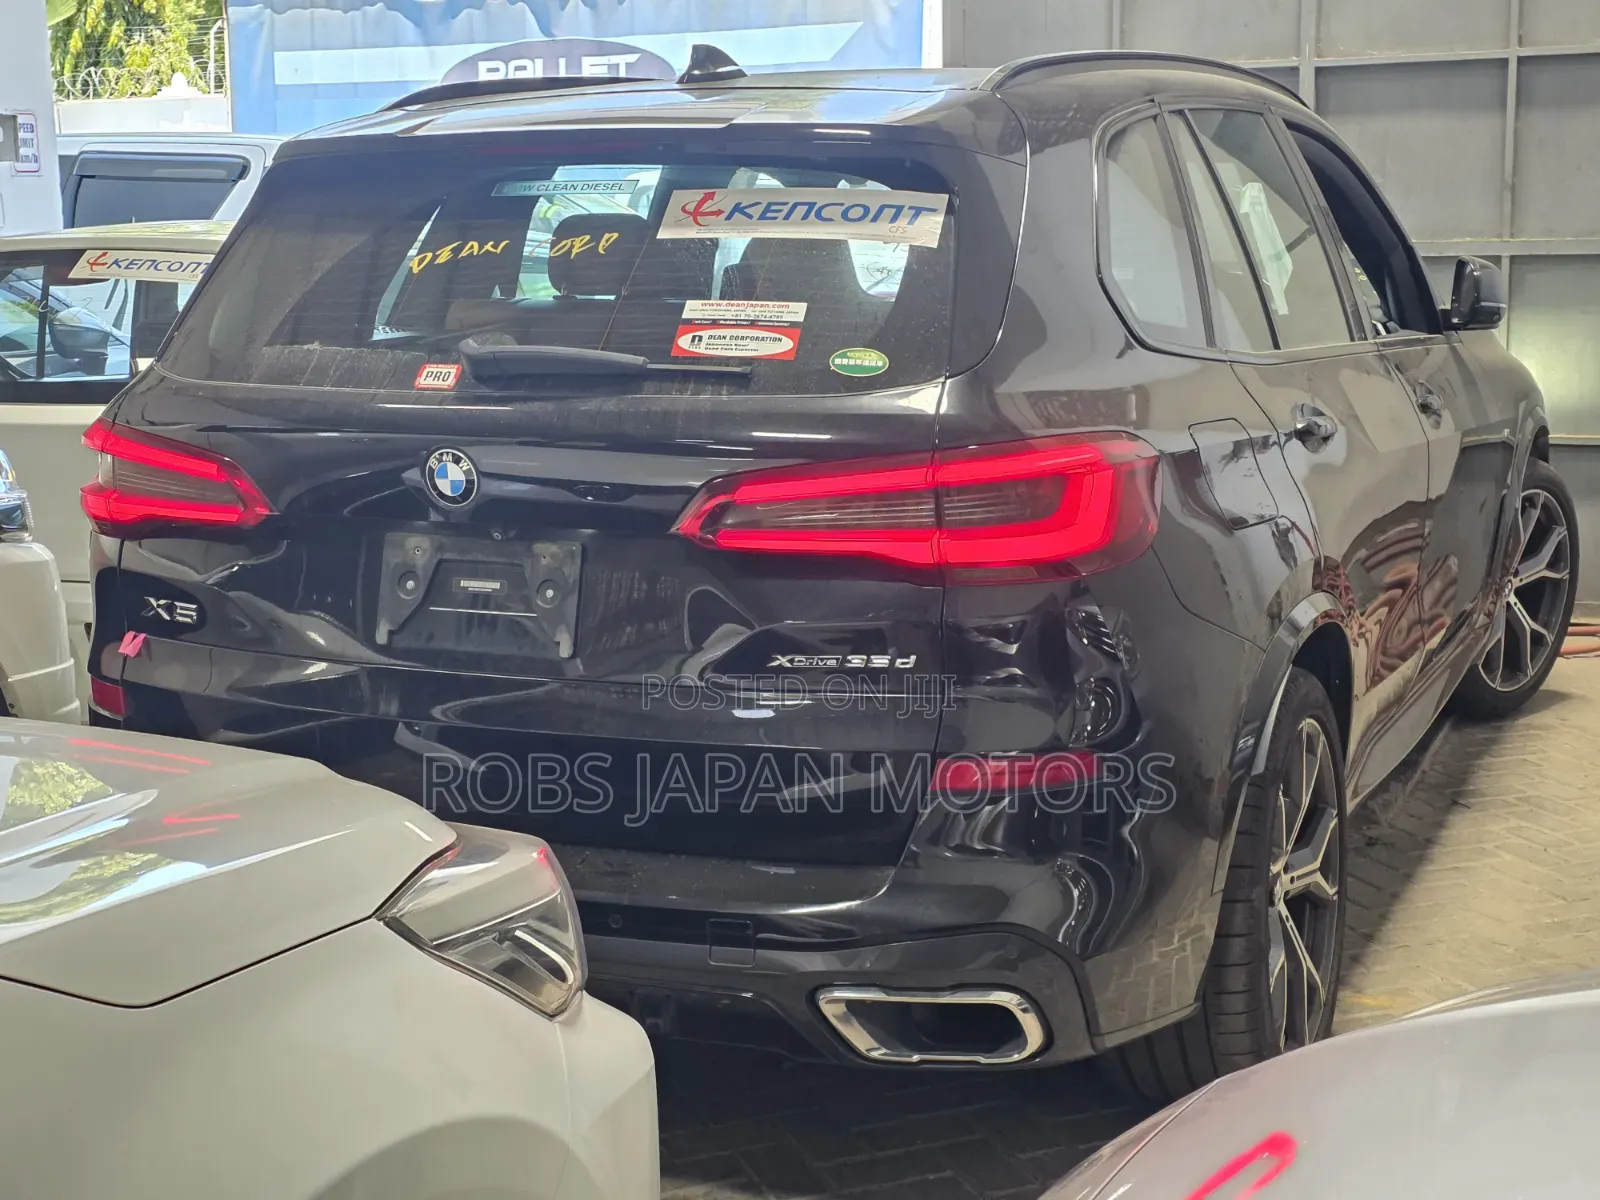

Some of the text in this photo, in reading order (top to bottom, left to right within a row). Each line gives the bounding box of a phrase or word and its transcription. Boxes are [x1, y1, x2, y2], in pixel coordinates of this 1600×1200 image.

[18, 122, 35, 134] PEED
[536, 183, 578, 192] CLEAN
[580, 182, 625, 191] DIESEL
[888, 225, 908, 235] CFS
[409, 240, 510, 274] DEAN
[700, 301, 790, 310] www.deanjapan.com
[729, 335, 783, 343] CORPORATION
[423, 370, 451, 382] PRO
[429, 452, 470, 470] BMW
[140, 596, 198, 624] X5
